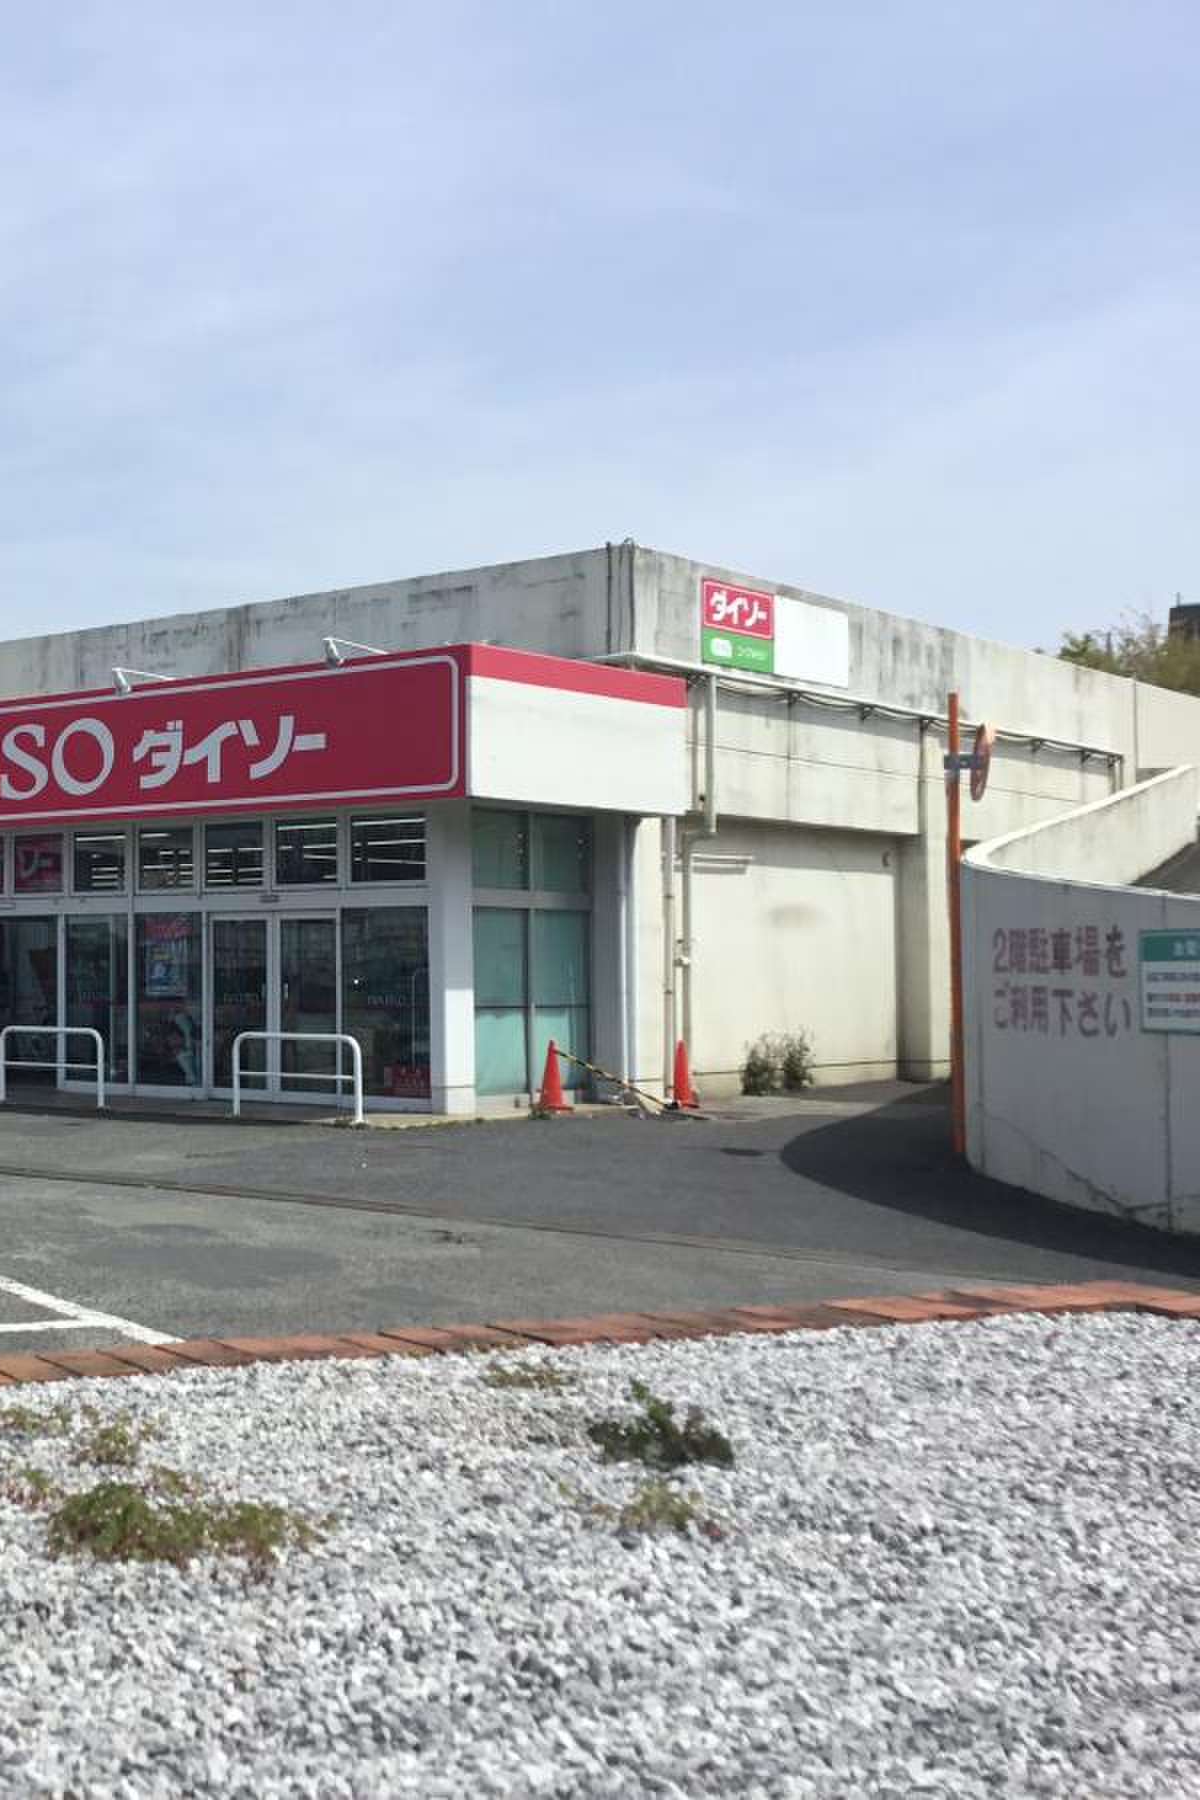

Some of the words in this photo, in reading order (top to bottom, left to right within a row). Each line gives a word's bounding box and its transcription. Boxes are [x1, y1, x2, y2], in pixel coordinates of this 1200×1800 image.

[709, 590, 768, 627] ダイソー
[133, 715, 327, 790] ダイソー
[992, 924, 1128, 978] 2階駐車場を
[993, 980, 1132, 1038] ご利用下さい
